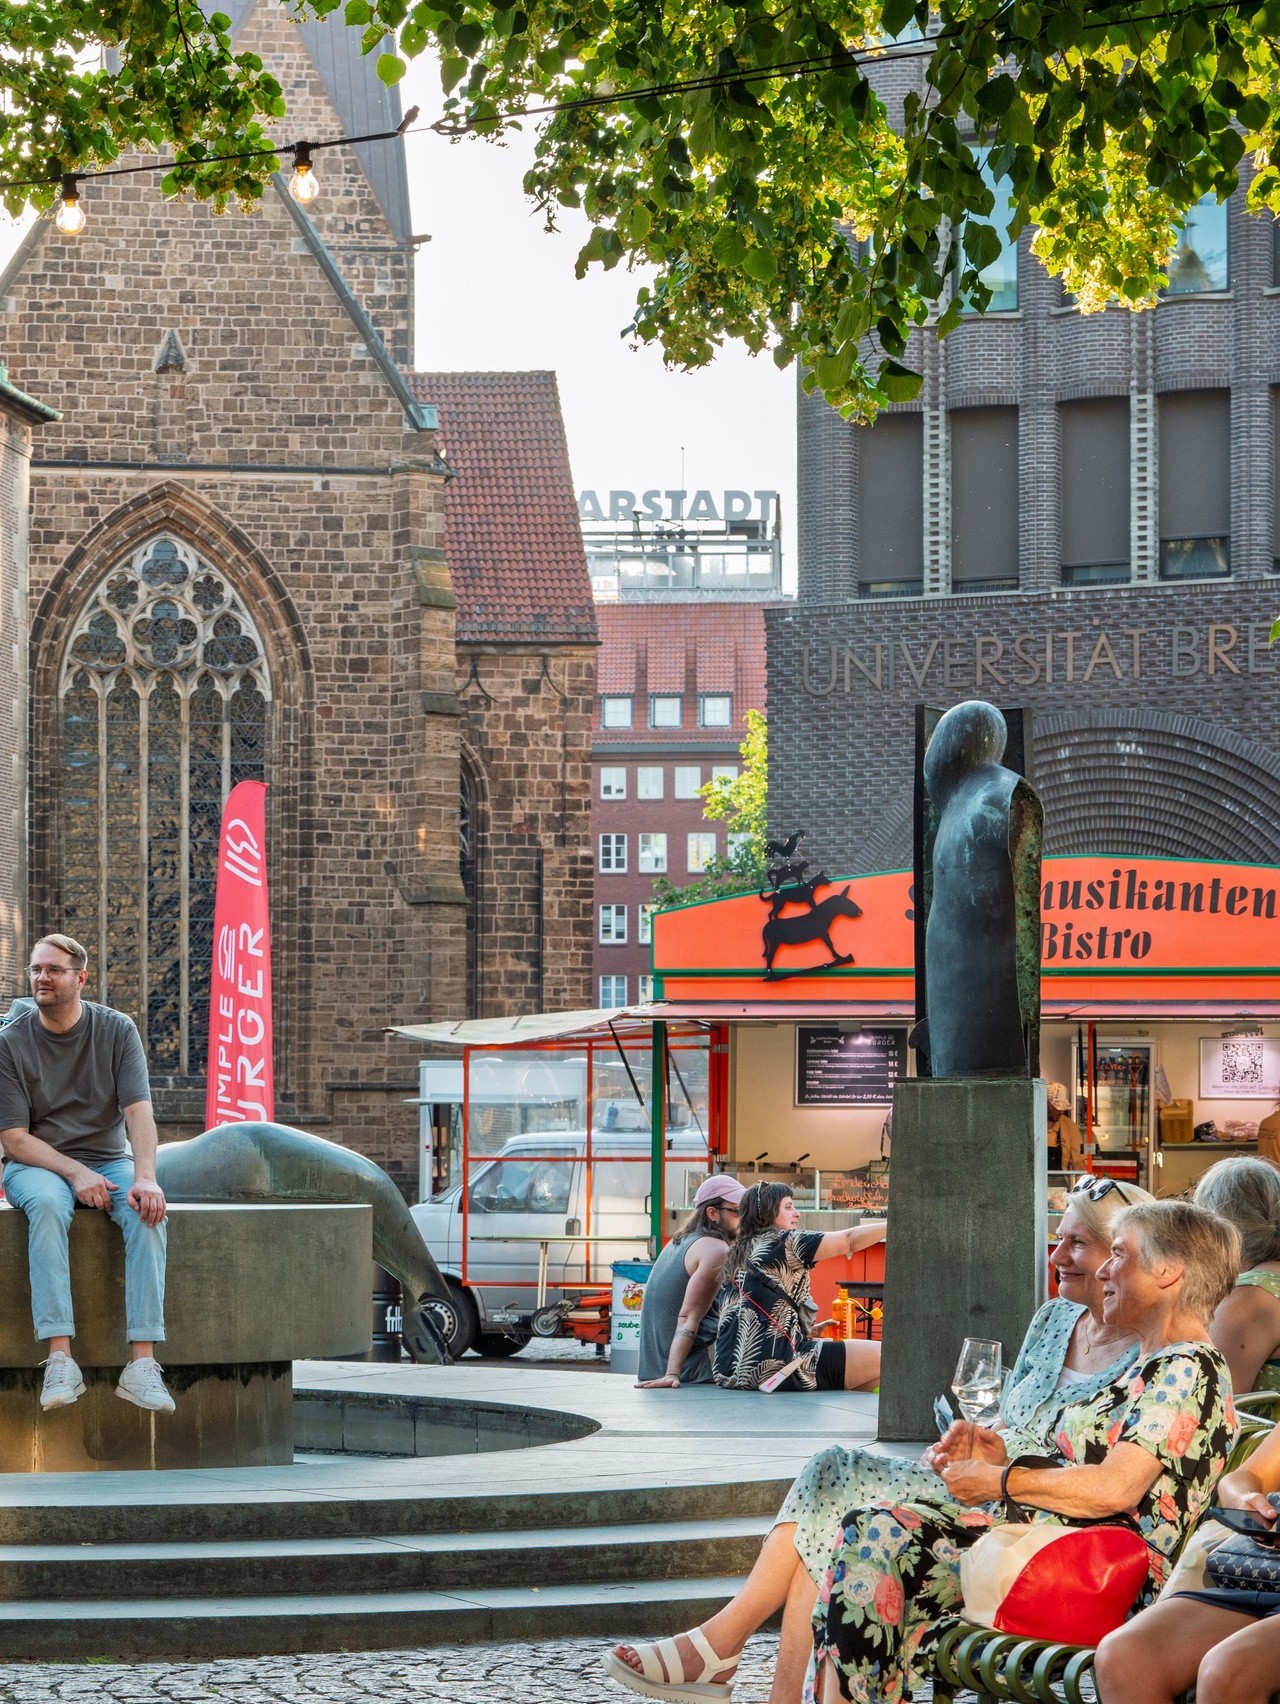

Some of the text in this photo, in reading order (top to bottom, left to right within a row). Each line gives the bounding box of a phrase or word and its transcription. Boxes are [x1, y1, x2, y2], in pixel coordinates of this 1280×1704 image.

[578, 490, 777, 520] ARSTADT
[803, 618, 1148, 696] UNIVERSITÄT
[1040, 922, 1152, 960] Bistro
[236, 922, 268, 1122] URGER
[216, 994, 246, 1125] IMPLE
[618, 1321, 640, 1329] saube
